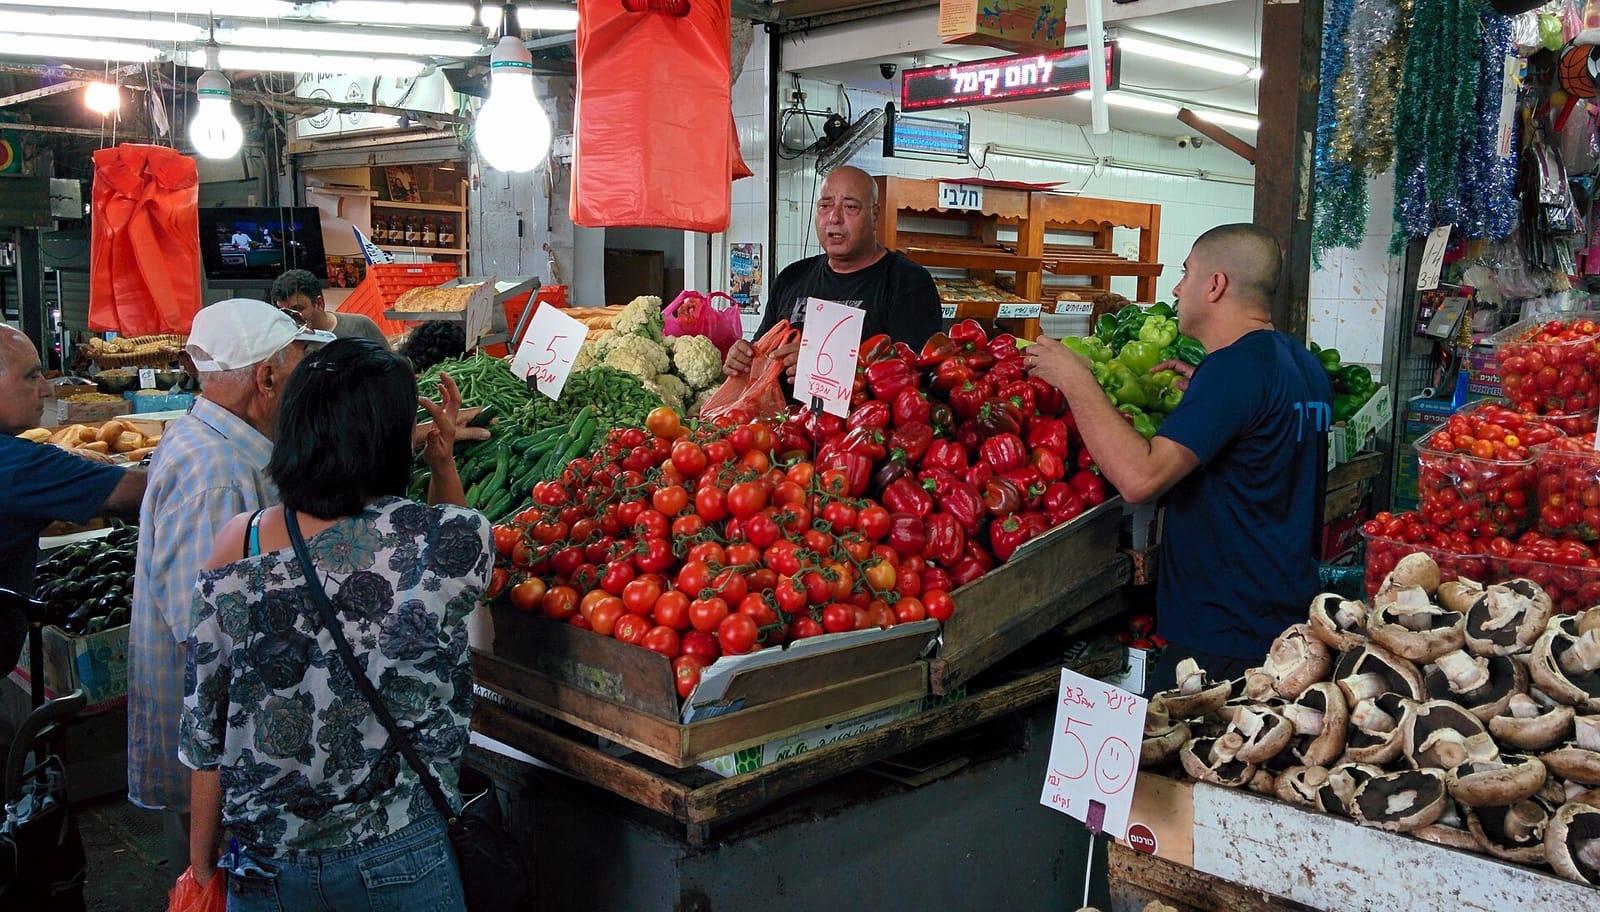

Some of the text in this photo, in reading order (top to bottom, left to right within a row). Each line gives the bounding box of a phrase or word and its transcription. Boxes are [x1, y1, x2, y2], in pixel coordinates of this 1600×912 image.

[950, 56, 1053, 96] לחם קימל
[943, 184, 979, 207] חלבי
[1130, 834, 1154, 846] כורכום
